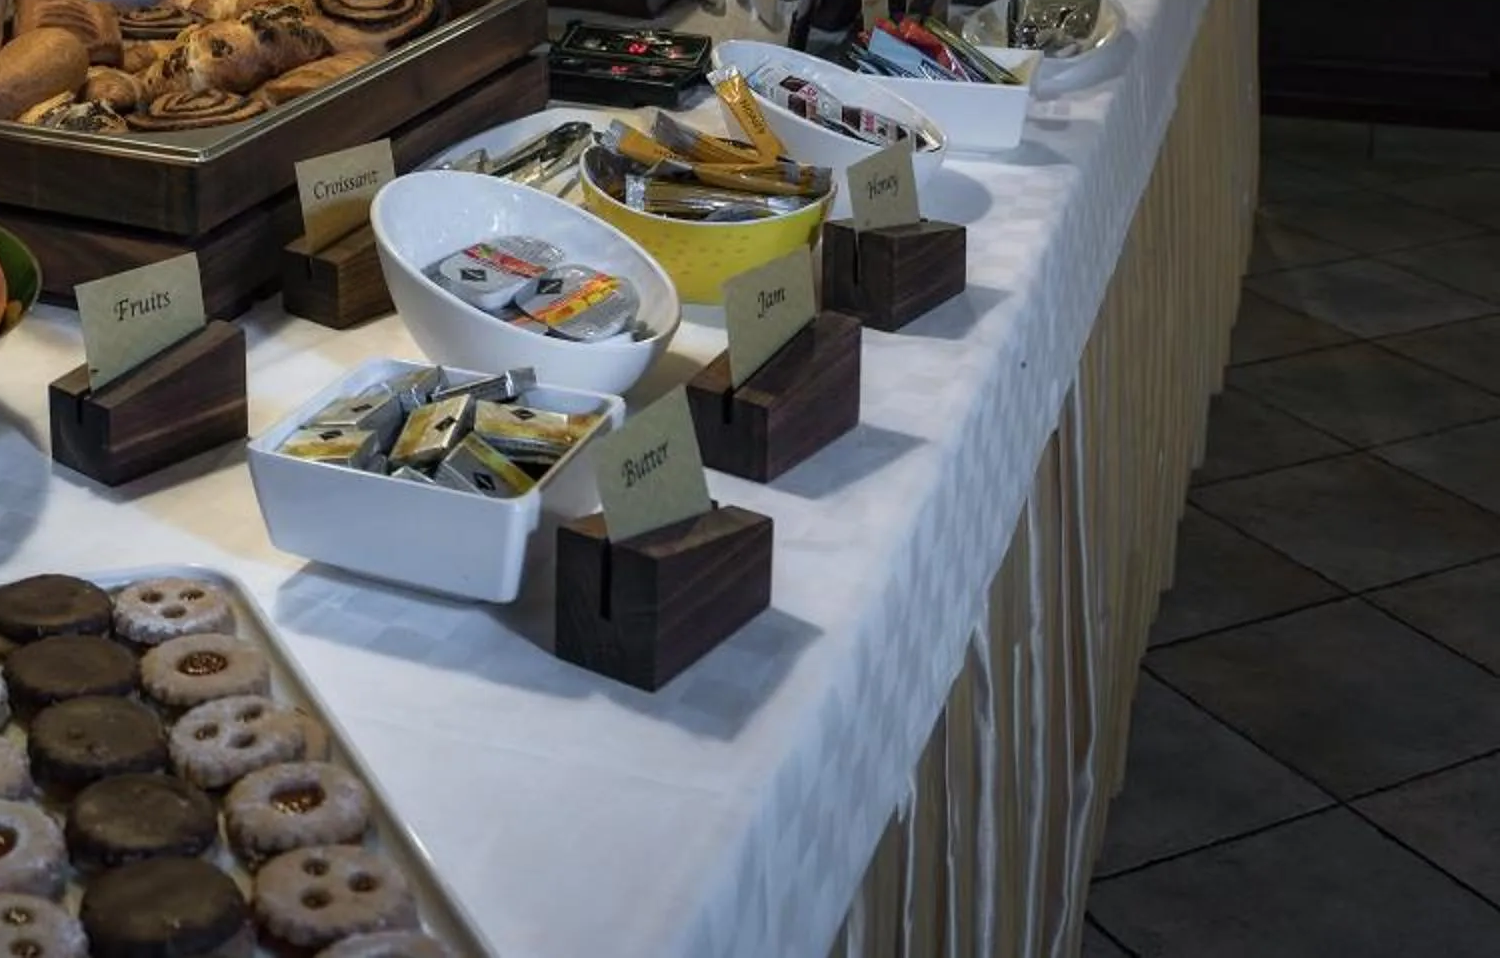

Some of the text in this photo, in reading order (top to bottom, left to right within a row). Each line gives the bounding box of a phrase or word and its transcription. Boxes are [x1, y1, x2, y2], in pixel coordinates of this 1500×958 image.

[313, 169, 379, 200] Croissant
[113, 290, 172, 322] Fruits
[757, 287, 786, 319] Jam
[621, 439, 669, 489] Butter
